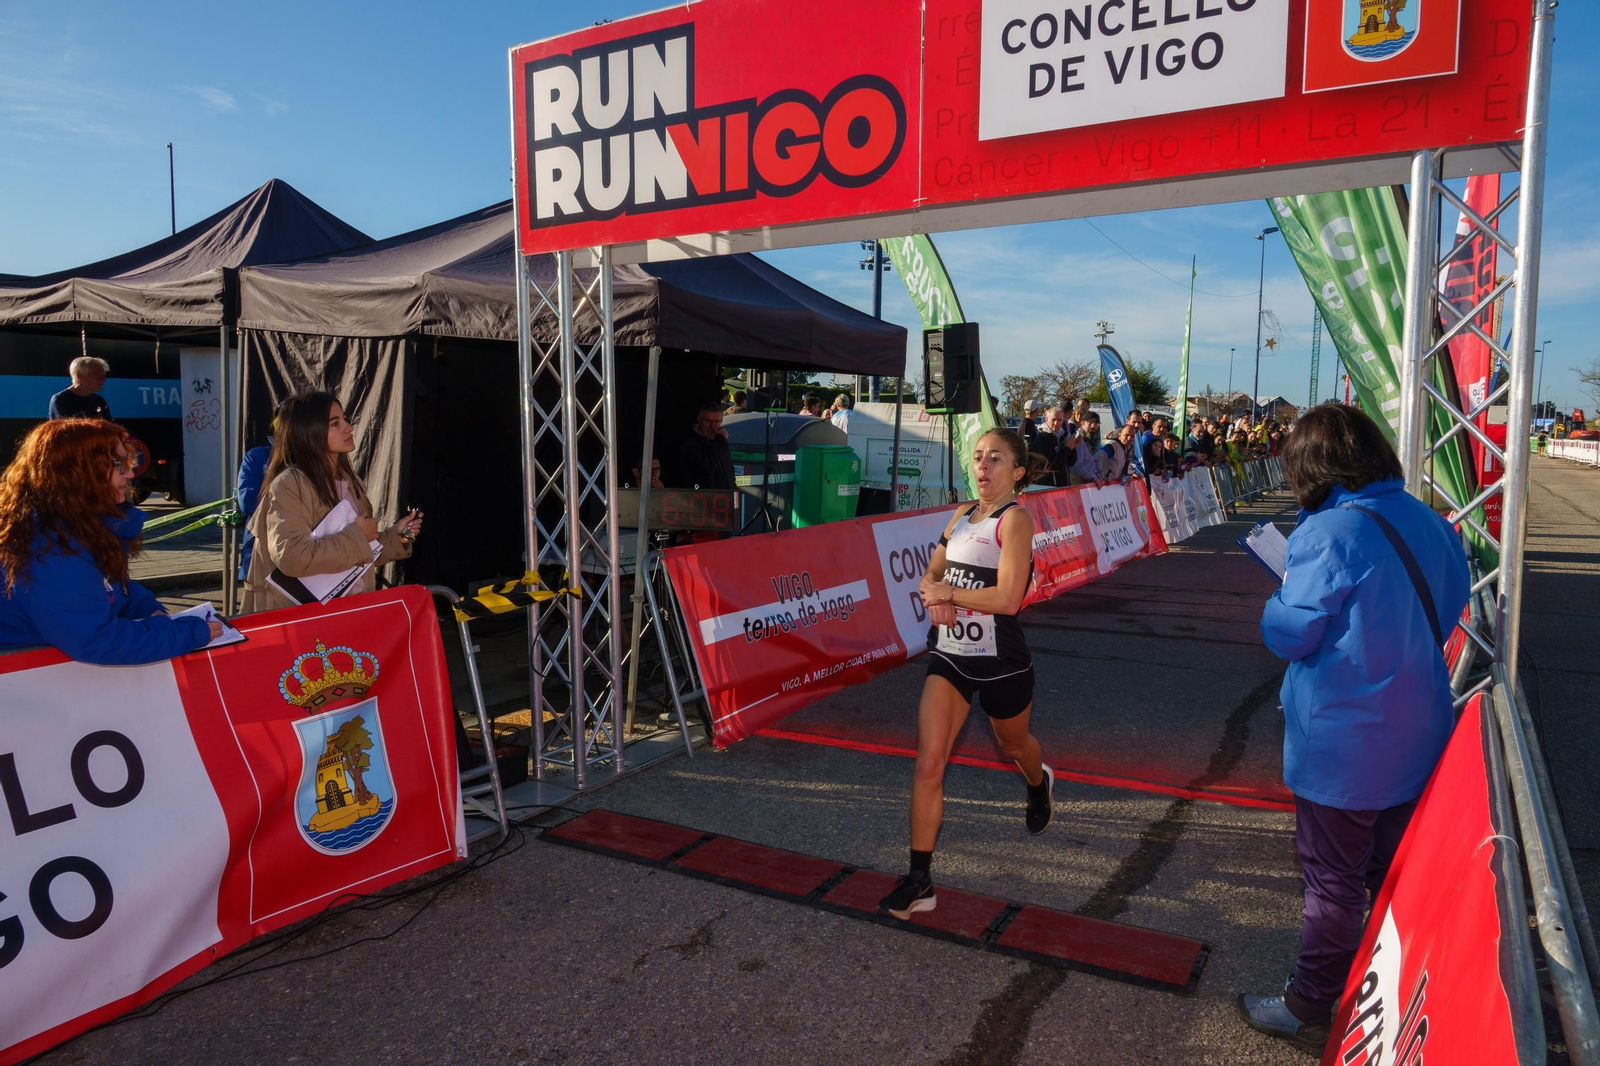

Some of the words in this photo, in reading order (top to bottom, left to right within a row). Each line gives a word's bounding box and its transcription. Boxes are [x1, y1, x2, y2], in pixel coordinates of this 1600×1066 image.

[1029, 55, 1085, 99] DE
[1104, 32, 1224, 85] VIGO
[533, 36, 687, 141] RUN
[934, 150, 1060, 188] Cáncer
[1094, 132, 1180, 172] Vigo
[1201, 113, 1262, 151] +11
[1308, 107, 1359, 142] La
[1380, 91, 1431, 134] 21
[138, 386, 182, 406] TRA
[889, 446, 921, 454] ROLLIDA
[889, 458, 920, 466] UADOS
[1090, 501, 1128, 526] CONCELLO
[1101, 531, 1115, 553] DE
[1111, 526, 1133, 550] VIGO
[770, 571, 819, 604] VIGO,
[743, 608, 797, 643] terreo
[799, 604, 818, 627] de
[821, 593, 856, 623] xogo
[946, 620, 984, 642] 100
[781, 679, 802, 693] VIGO,
[803, 673, 811, 683] A
[813, 661, 845, 681] MELLOR
[845, 652, 872, 669] CIDADE
[871, 648, 886, 660] PARA
[886, 642, 900, 655] VIVIR
[0, 730, 145, 836] LO
